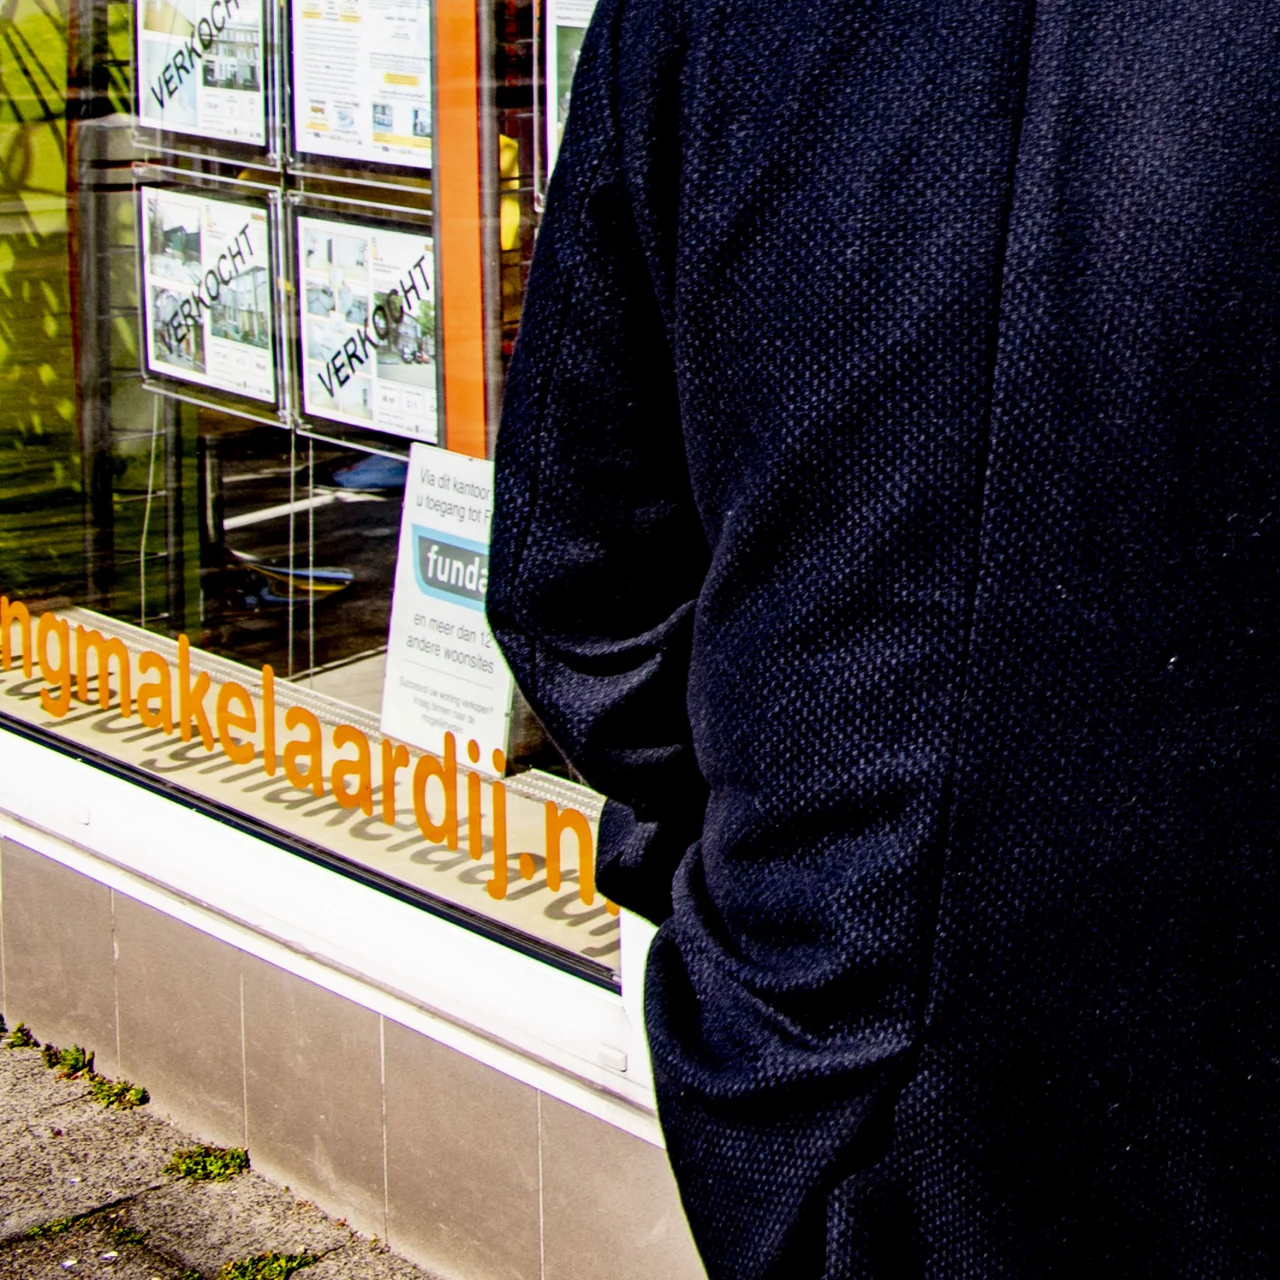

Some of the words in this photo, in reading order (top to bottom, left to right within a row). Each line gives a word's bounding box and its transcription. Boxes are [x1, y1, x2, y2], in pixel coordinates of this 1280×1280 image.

[161, 224, 254, 355] VERKOCHT
[318, 255, 430, 399] VERKOCHT
[420, 468, 436, 486] Via
[438, 474, 450, 490] dit
[453, 480, 491, 500] kantoor
[416, 496, 423, 506] u
[426, 496, 466, 524] toegang
[468, 508, 481, 523] tot
[414, 614, 426, 628] en
[429, 618, 454, 636] meer
[457, 626, 476, 643] dan
[406, 634, 440, 657] andere
[444, 649, 494, 675] woonsites
